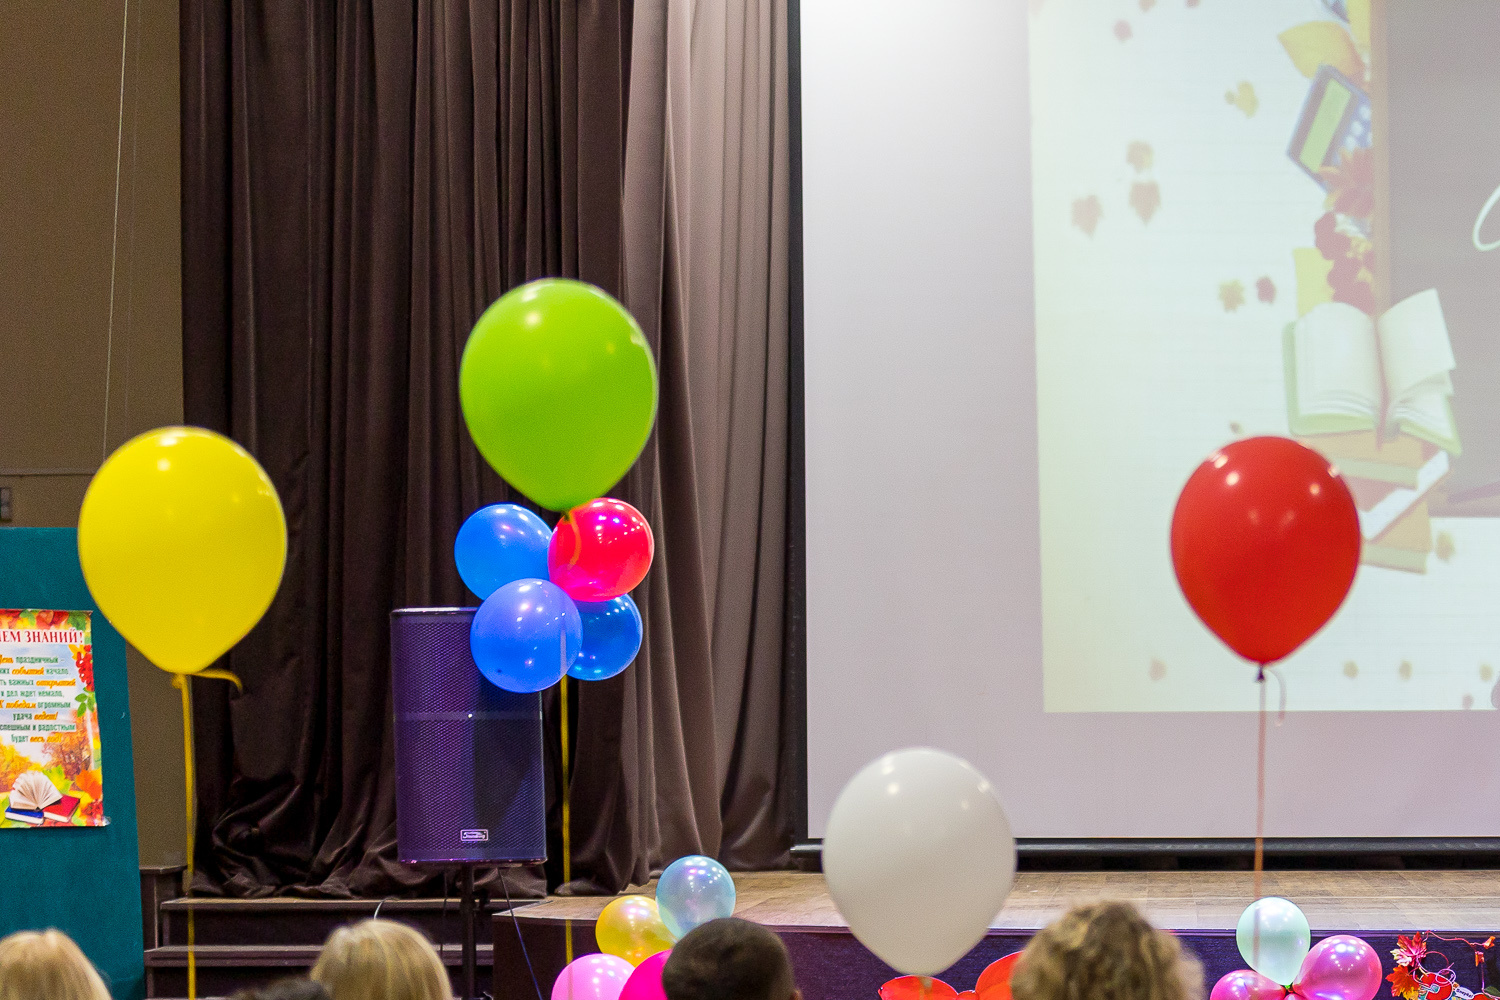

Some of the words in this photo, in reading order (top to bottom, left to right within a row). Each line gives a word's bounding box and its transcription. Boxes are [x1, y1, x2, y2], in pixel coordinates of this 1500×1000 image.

[0, 631, 20, 642] ЕМ
[25, 628, 82, 642] ЗНАНИЙ!
[15, 656, 58, 664] праздничный
[12, 666, 44, 675] событий
[36, 679, 76, 688] открытий
[6, 699, 37, 709] победам
[37, 701, 71, 709] огромным
[13, 713, 32, 721] удача
[38, 724, 76, 732] радостным
[11, 734, 28, 743] будет
